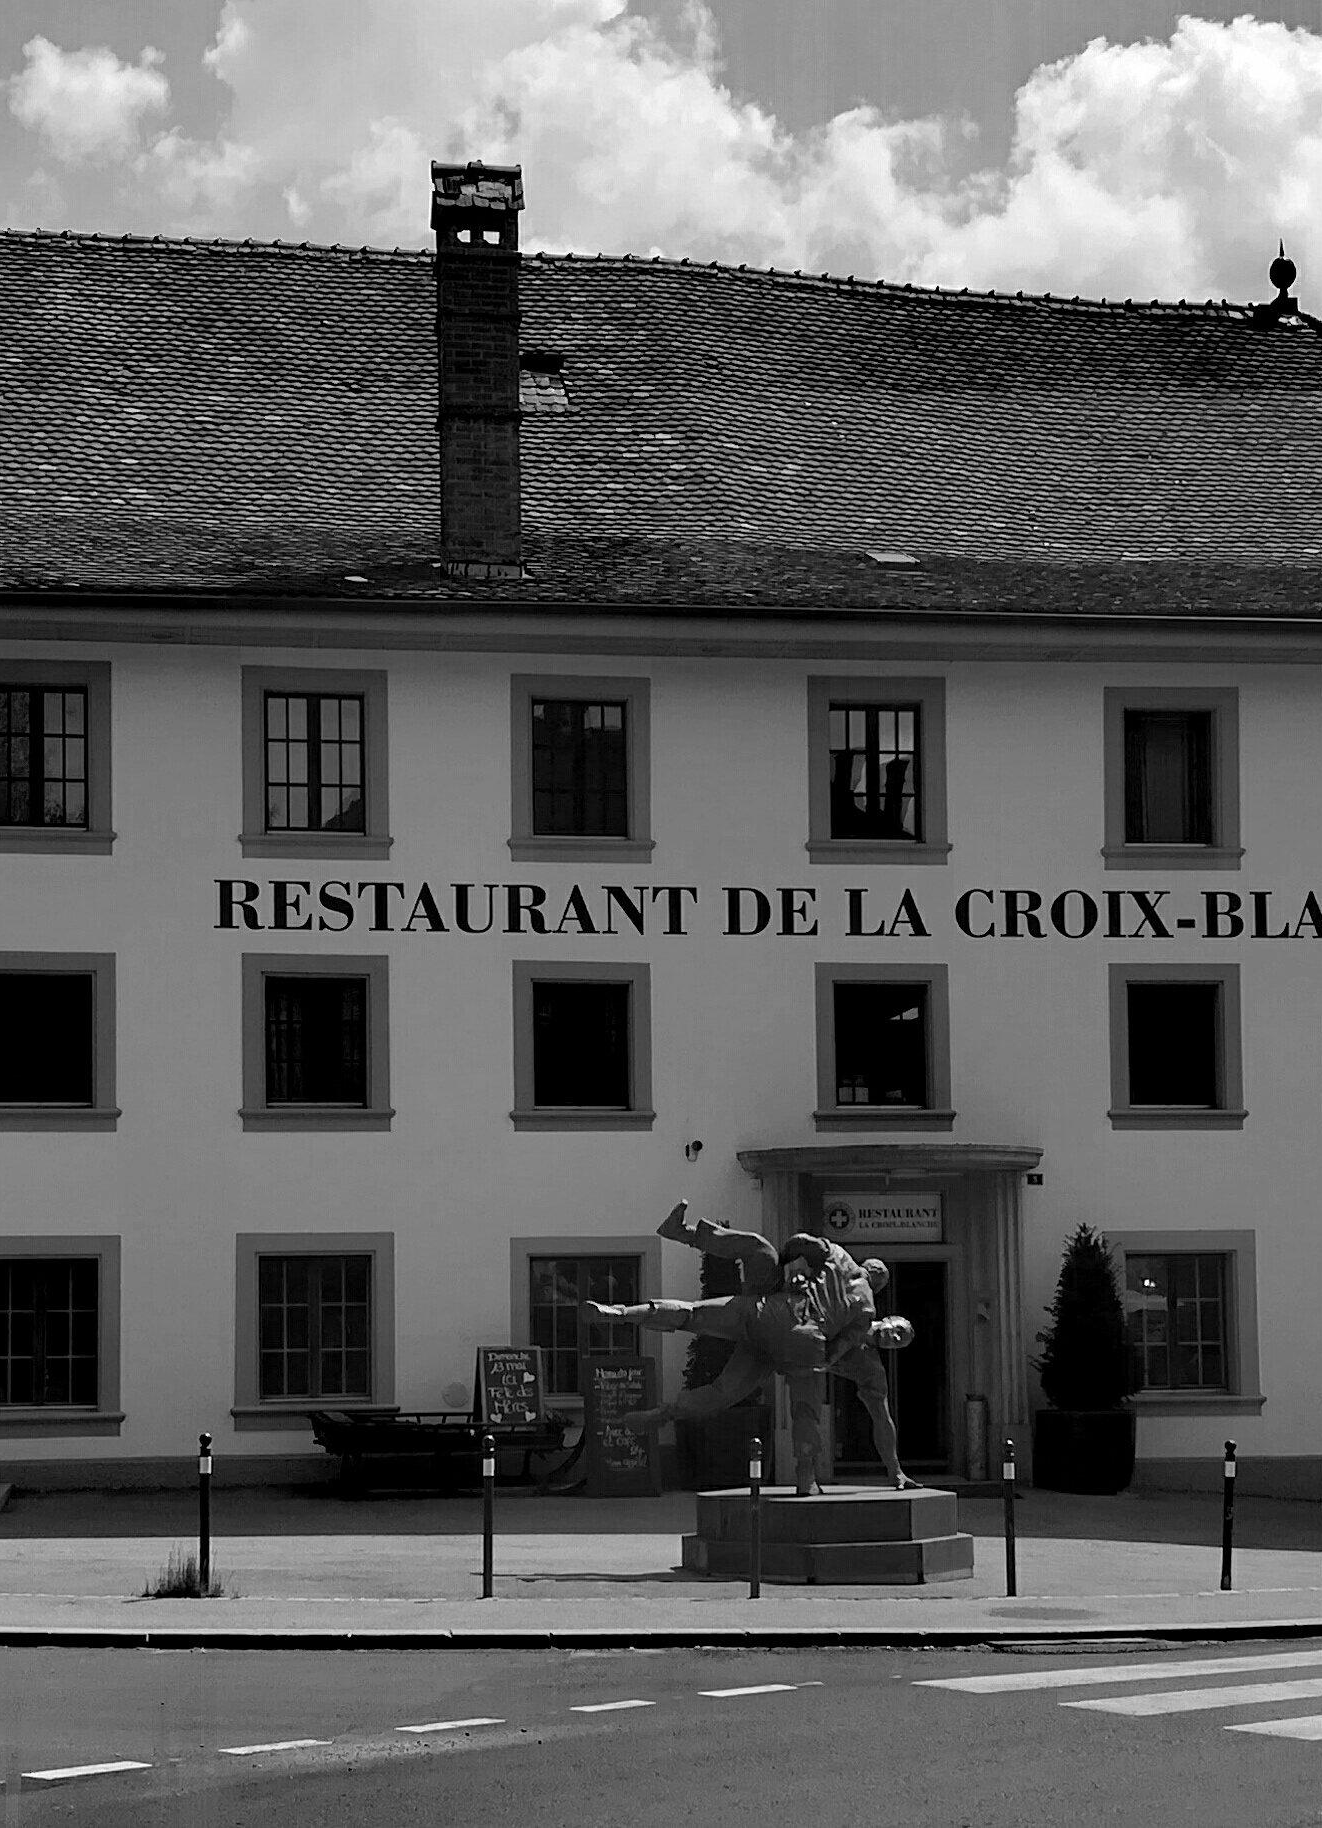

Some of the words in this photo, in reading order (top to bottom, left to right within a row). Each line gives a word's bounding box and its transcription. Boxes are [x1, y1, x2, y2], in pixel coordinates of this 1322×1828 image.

[213, 879, 698, 936] RESTAURANT
[721, 887, 819, 936] DE
[844, 888, 932, 937] LA
[858, 1208, 938, 1219] RESTAURANT
[506, 1362, 527, 1371] mai
[516, 1384, 533, 1397] des
